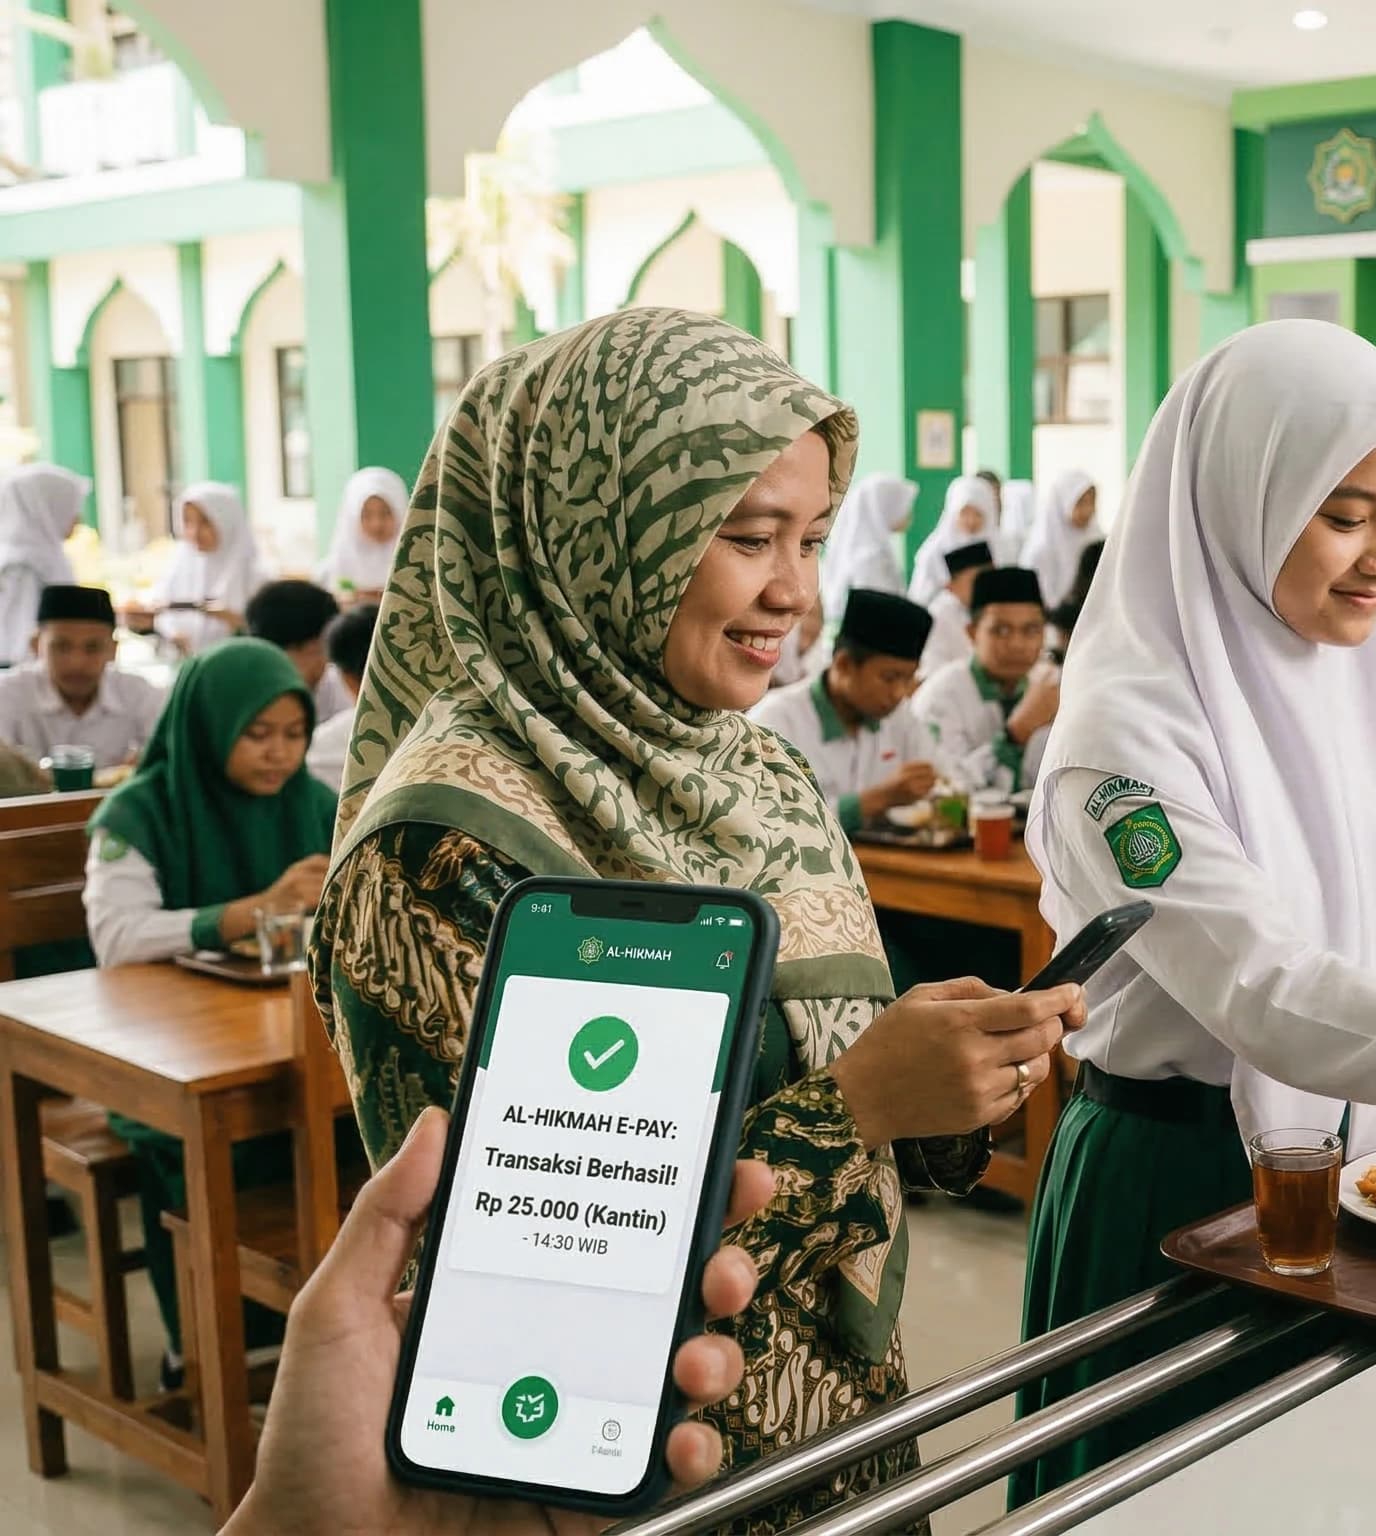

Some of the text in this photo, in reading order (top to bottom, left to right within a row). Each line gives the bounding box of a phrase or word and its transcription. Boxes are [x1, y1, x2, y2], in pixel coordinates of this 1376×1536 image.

[607, 946, 672, 961] AL-HIKMAH
[502, 1105, 679, 1140] AL-HIKMAH E-PAY:
[484, 1146, 679, 1187] Transaksi Berhasil!
[475, 1191, 667, 1235] Rp 25.000 (Kantin)
[532, 1232, 575, 1252] 14:30
[577, 1237, 609, 1256] WIB
[426, 1419, 456, 1433] Home
